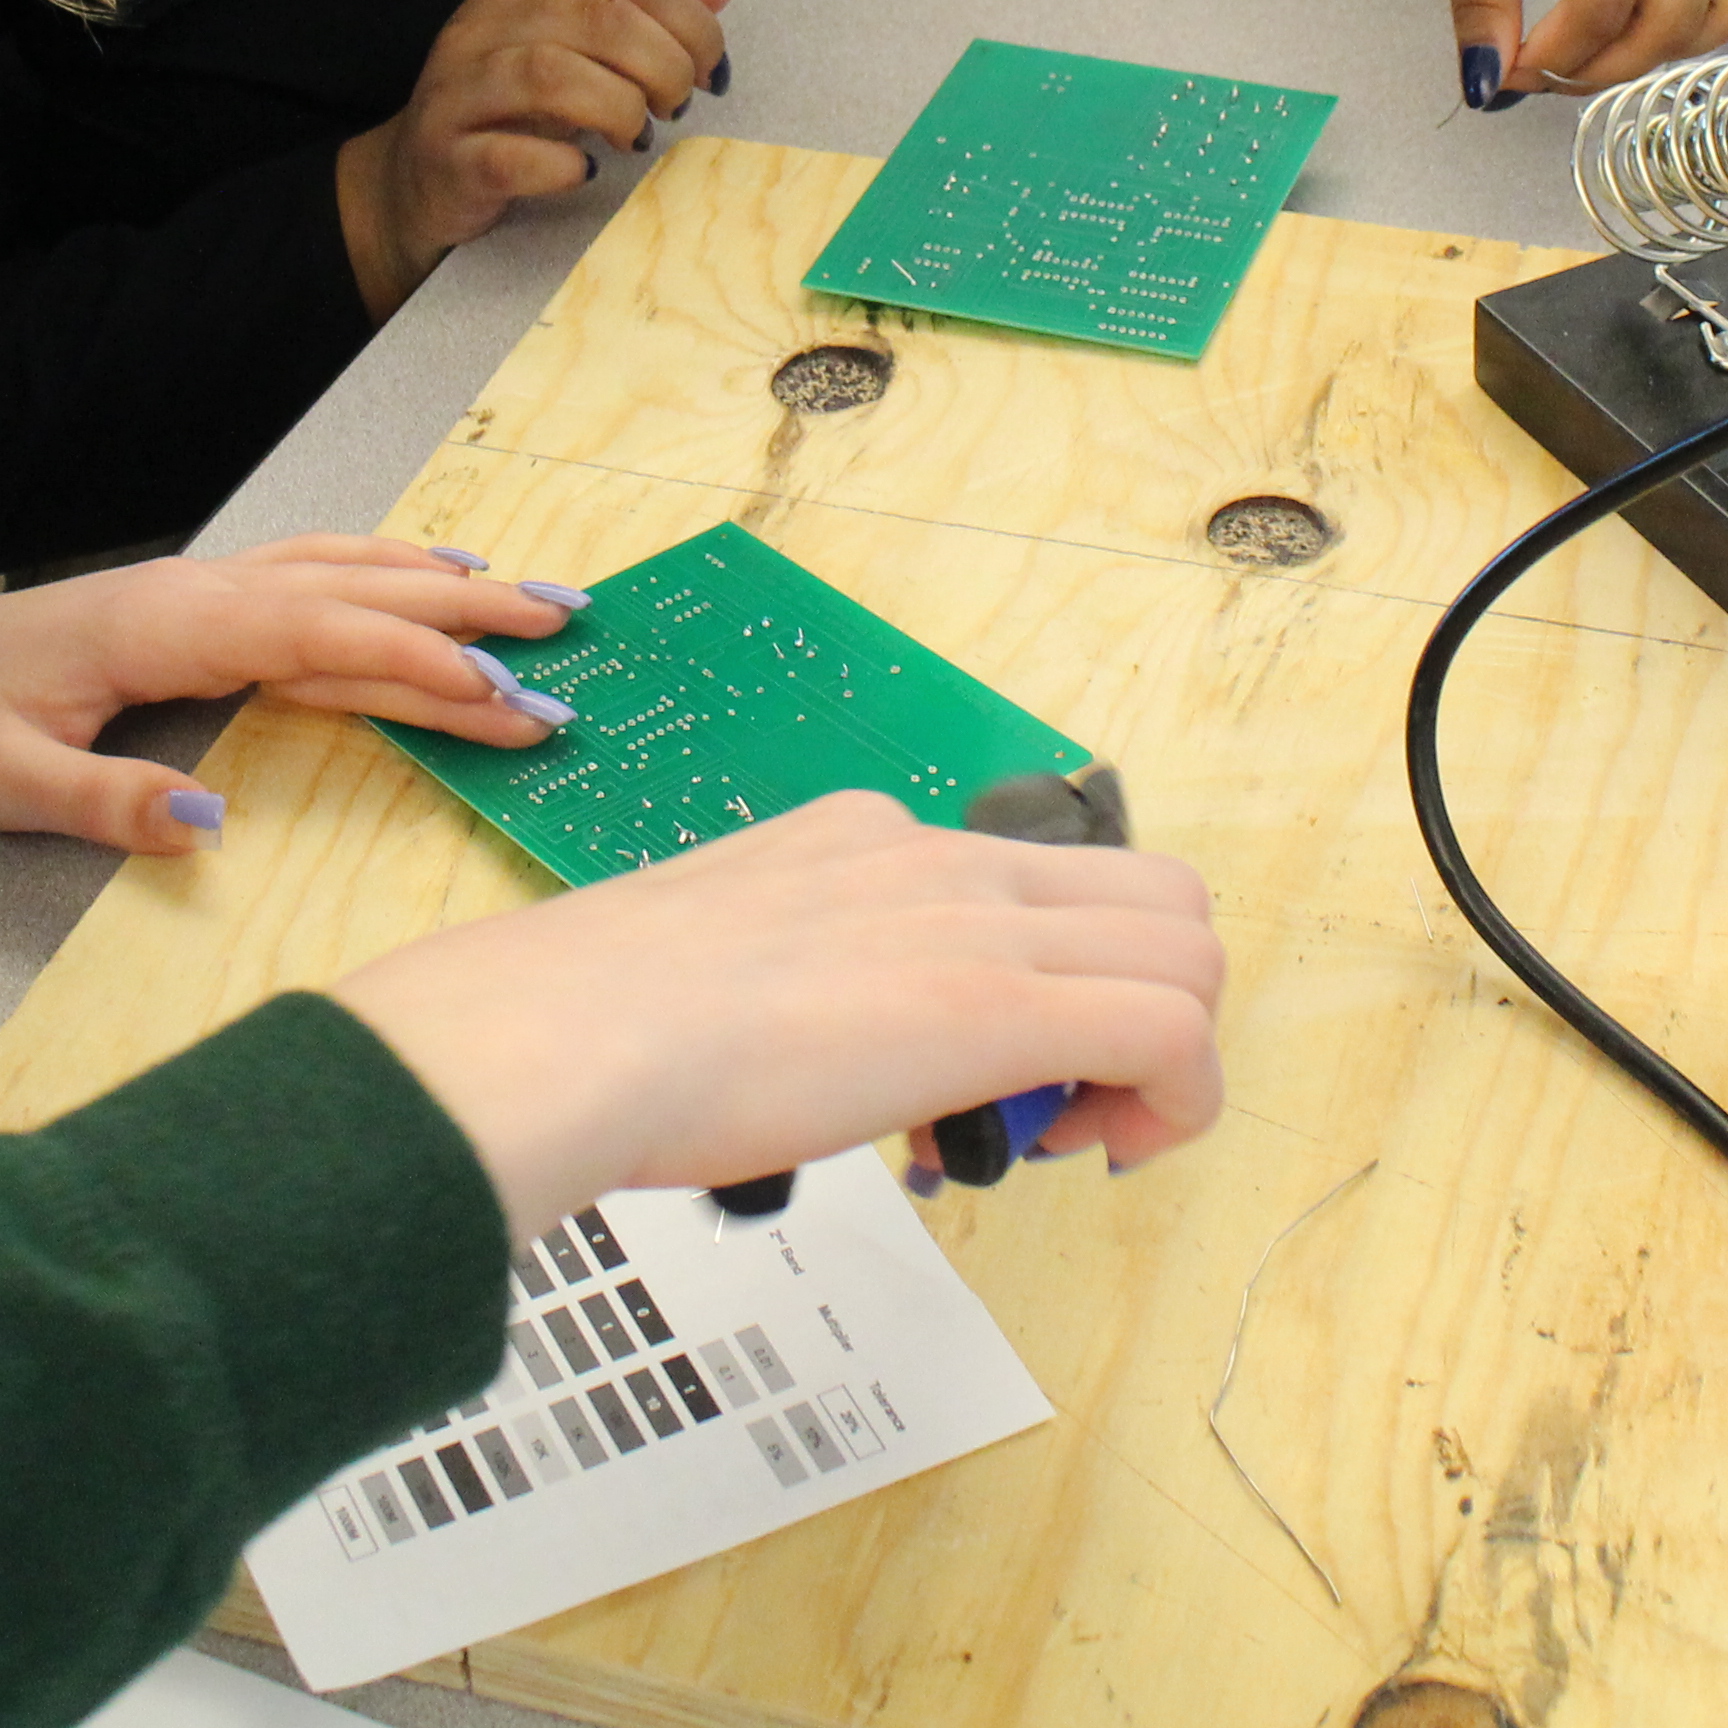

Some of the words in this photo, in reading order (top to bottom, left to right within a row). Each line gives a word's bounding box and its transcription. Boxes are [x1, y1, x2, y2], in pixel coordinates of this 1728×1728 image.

[780, 1246, 806, 1276] Band
[817, 1303, 855, 1352] Multiplier
[870, 1380, 907, 1432] Tolerance
